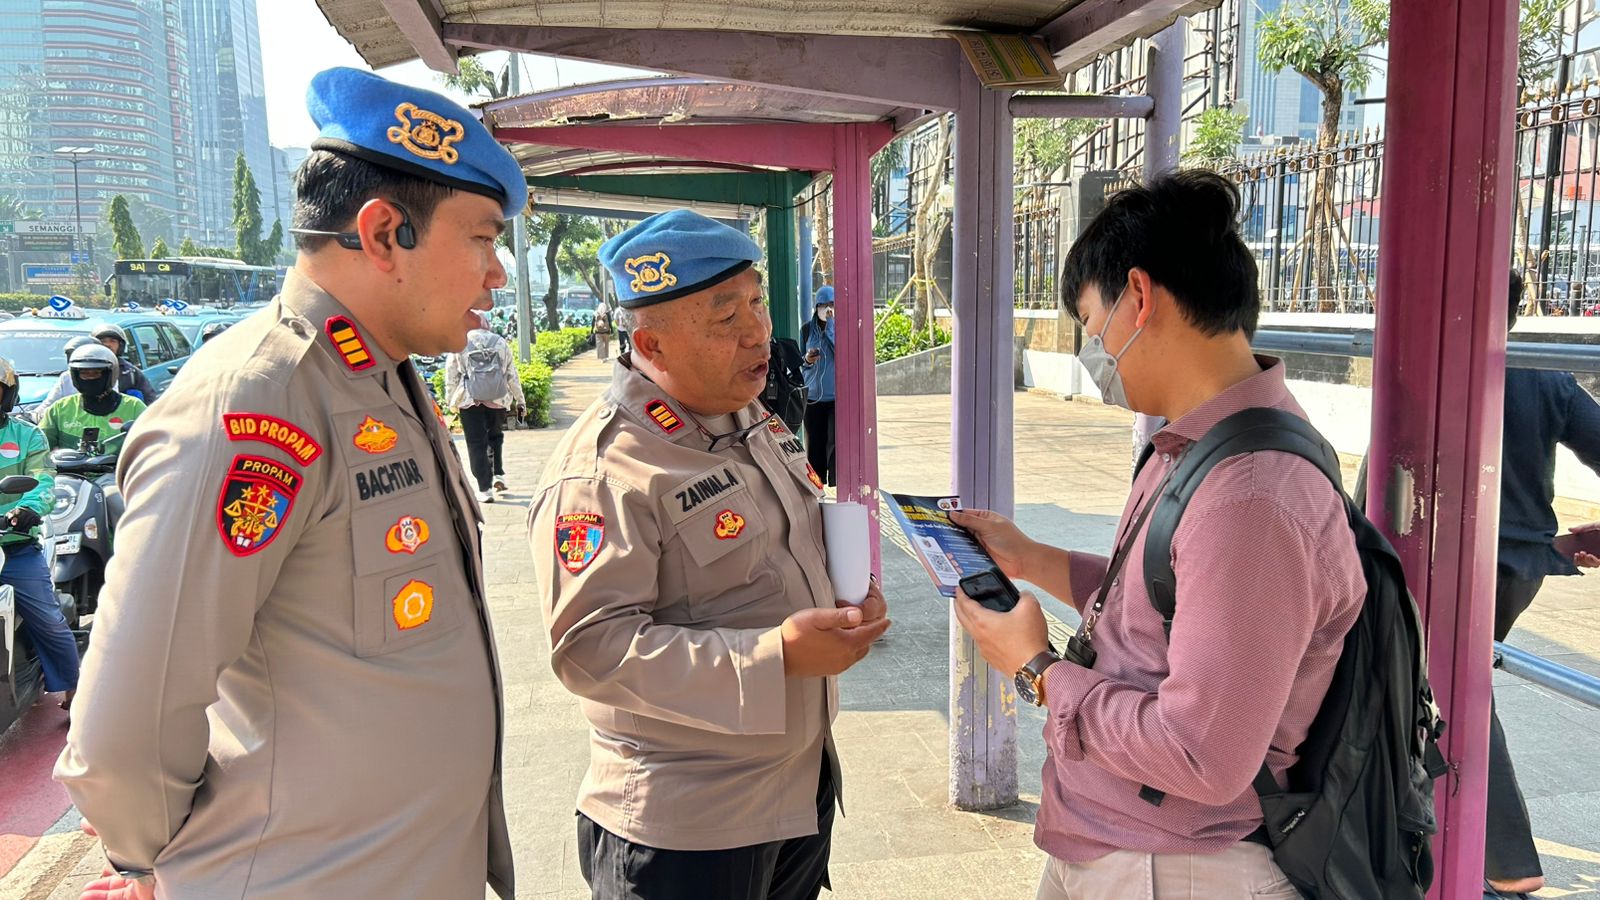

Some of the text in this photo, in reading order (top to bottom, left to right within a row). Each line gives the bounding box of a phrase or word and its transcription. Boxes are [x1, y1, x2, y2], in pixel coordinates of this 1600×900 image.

[229, 418, 317, 461] BID PROPAM
[242, 461, 294, 486] PROPAM
[355, 457, 424, 501] BACHTIAR
[562, 514, 597, 523] PROPAM
